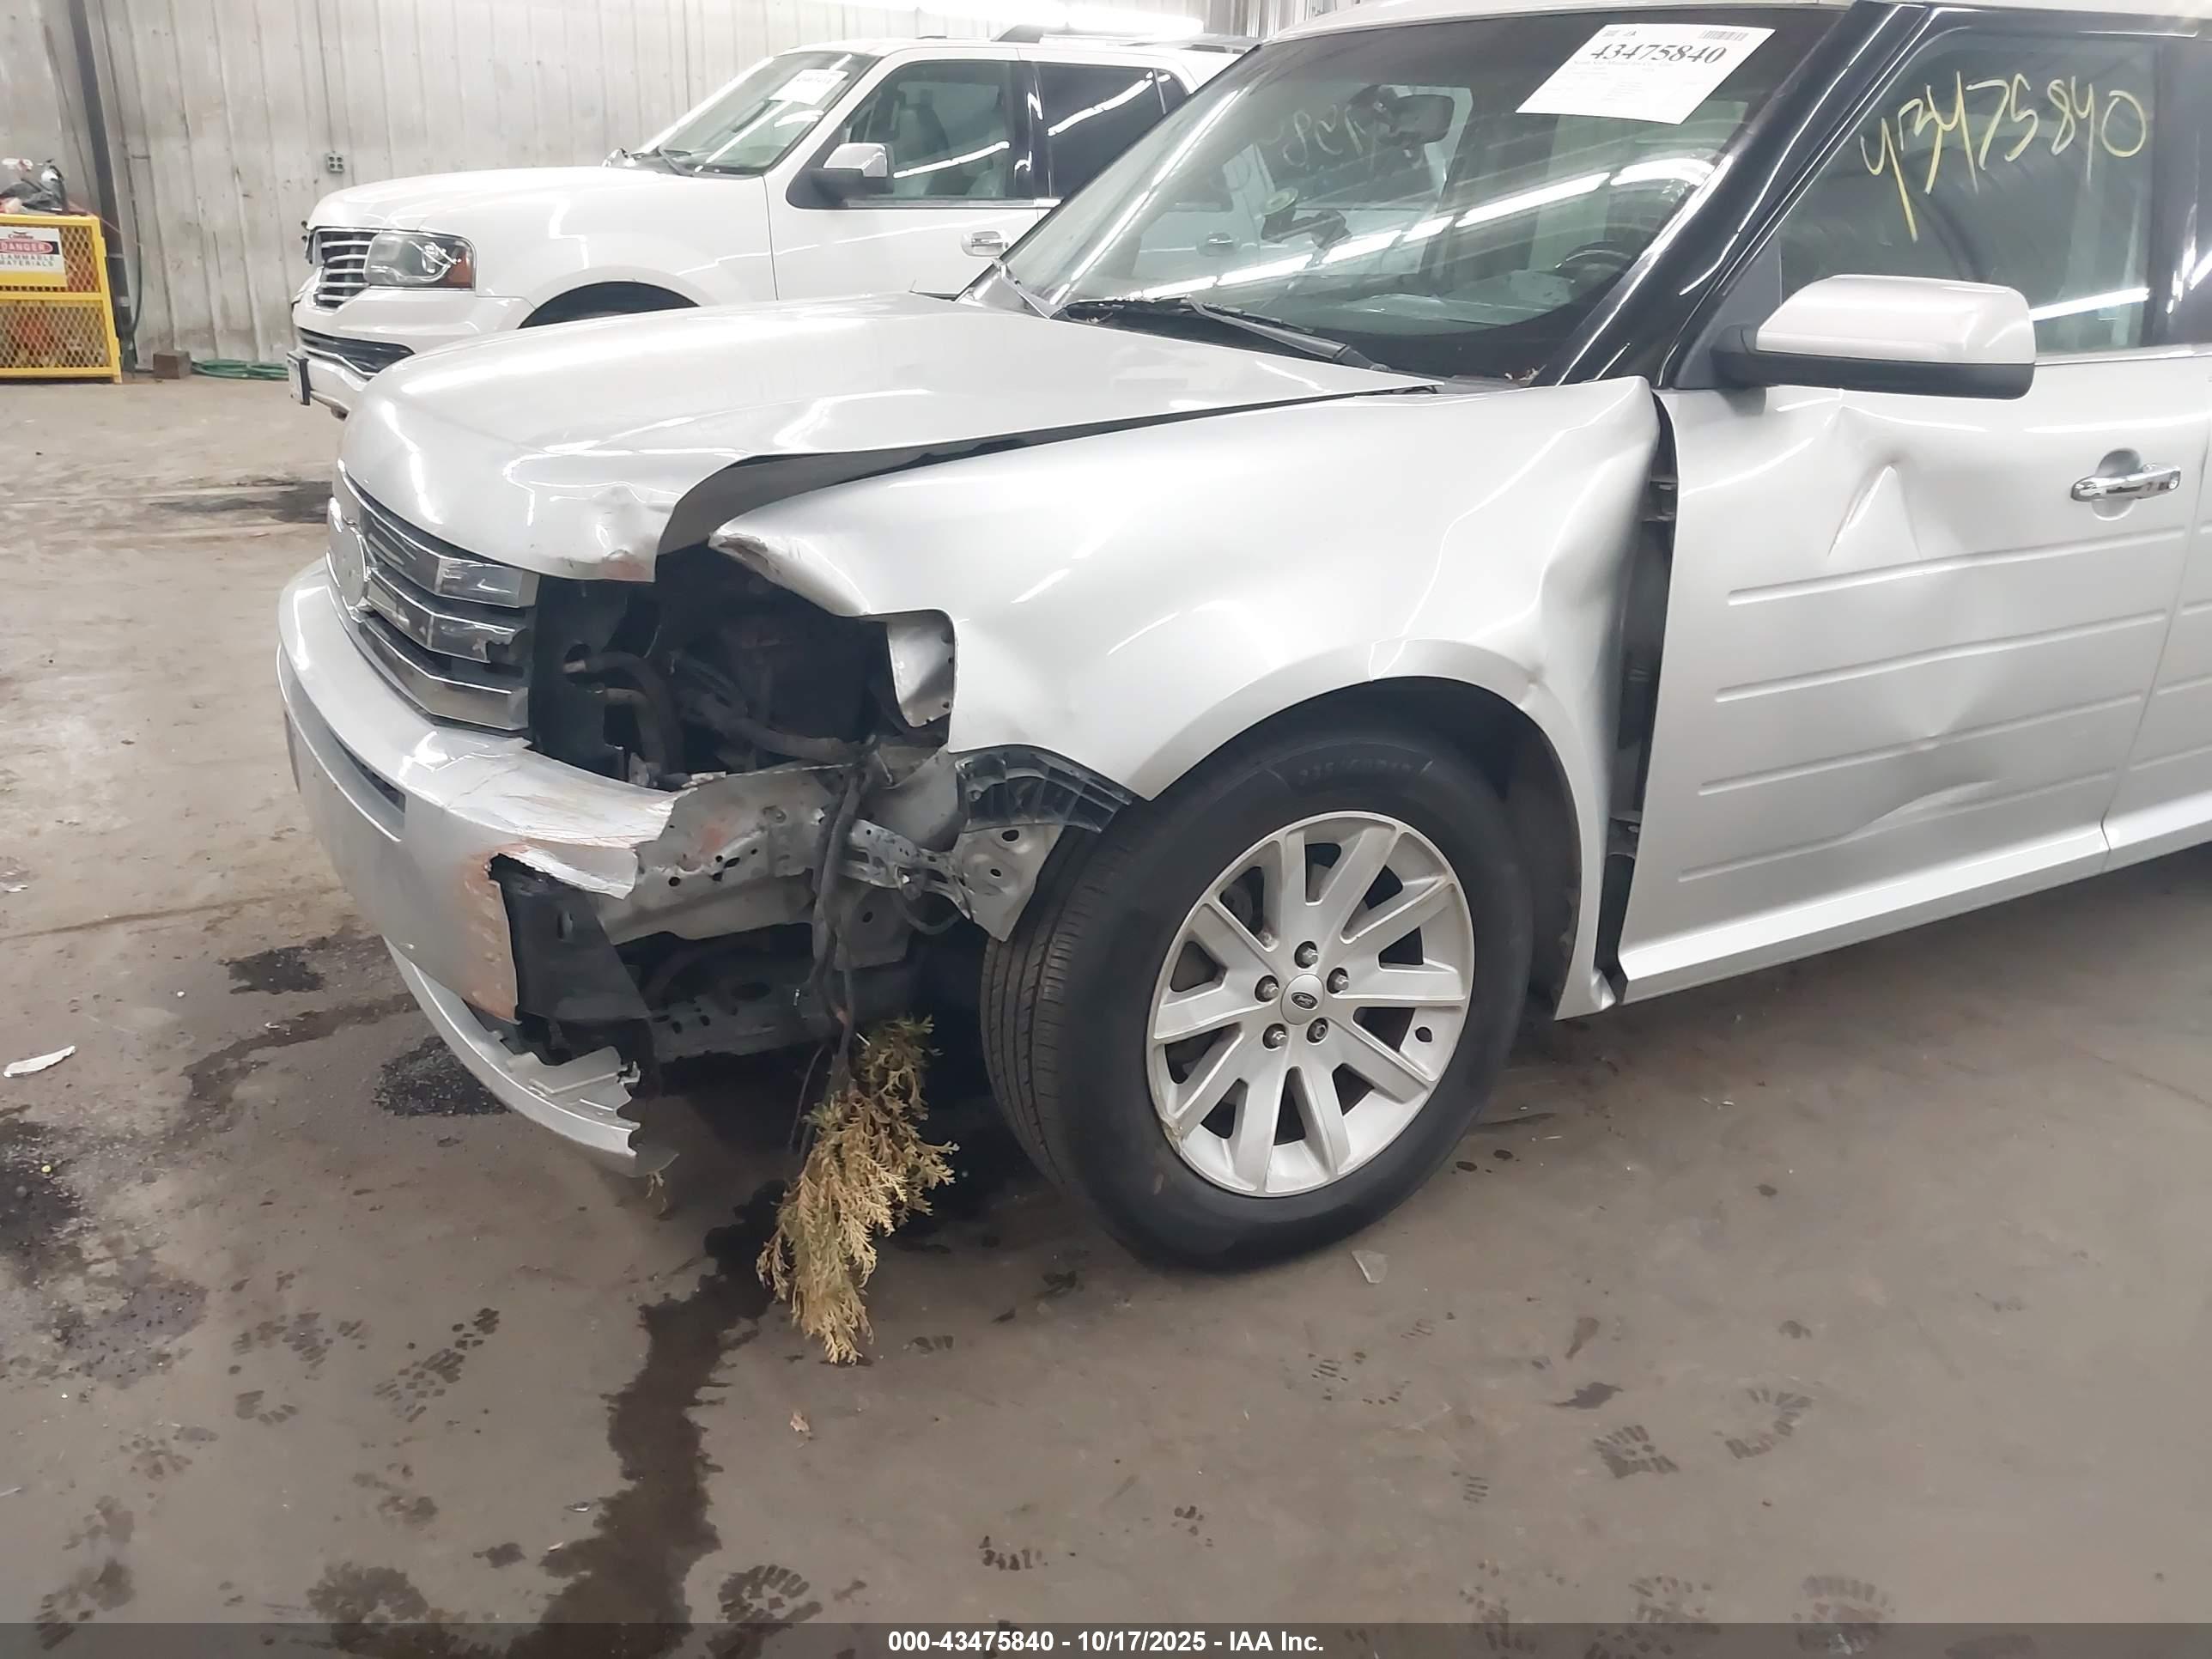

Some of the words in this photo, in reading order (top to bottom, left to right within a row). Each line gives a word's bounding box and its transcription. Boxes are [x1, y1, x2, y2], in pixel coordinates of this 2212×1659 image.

[1590, 43, 1728, 64] 43475840
[1860, 70, 2147, 242] 43475840
[1, 241, 45, 252] DANGER
